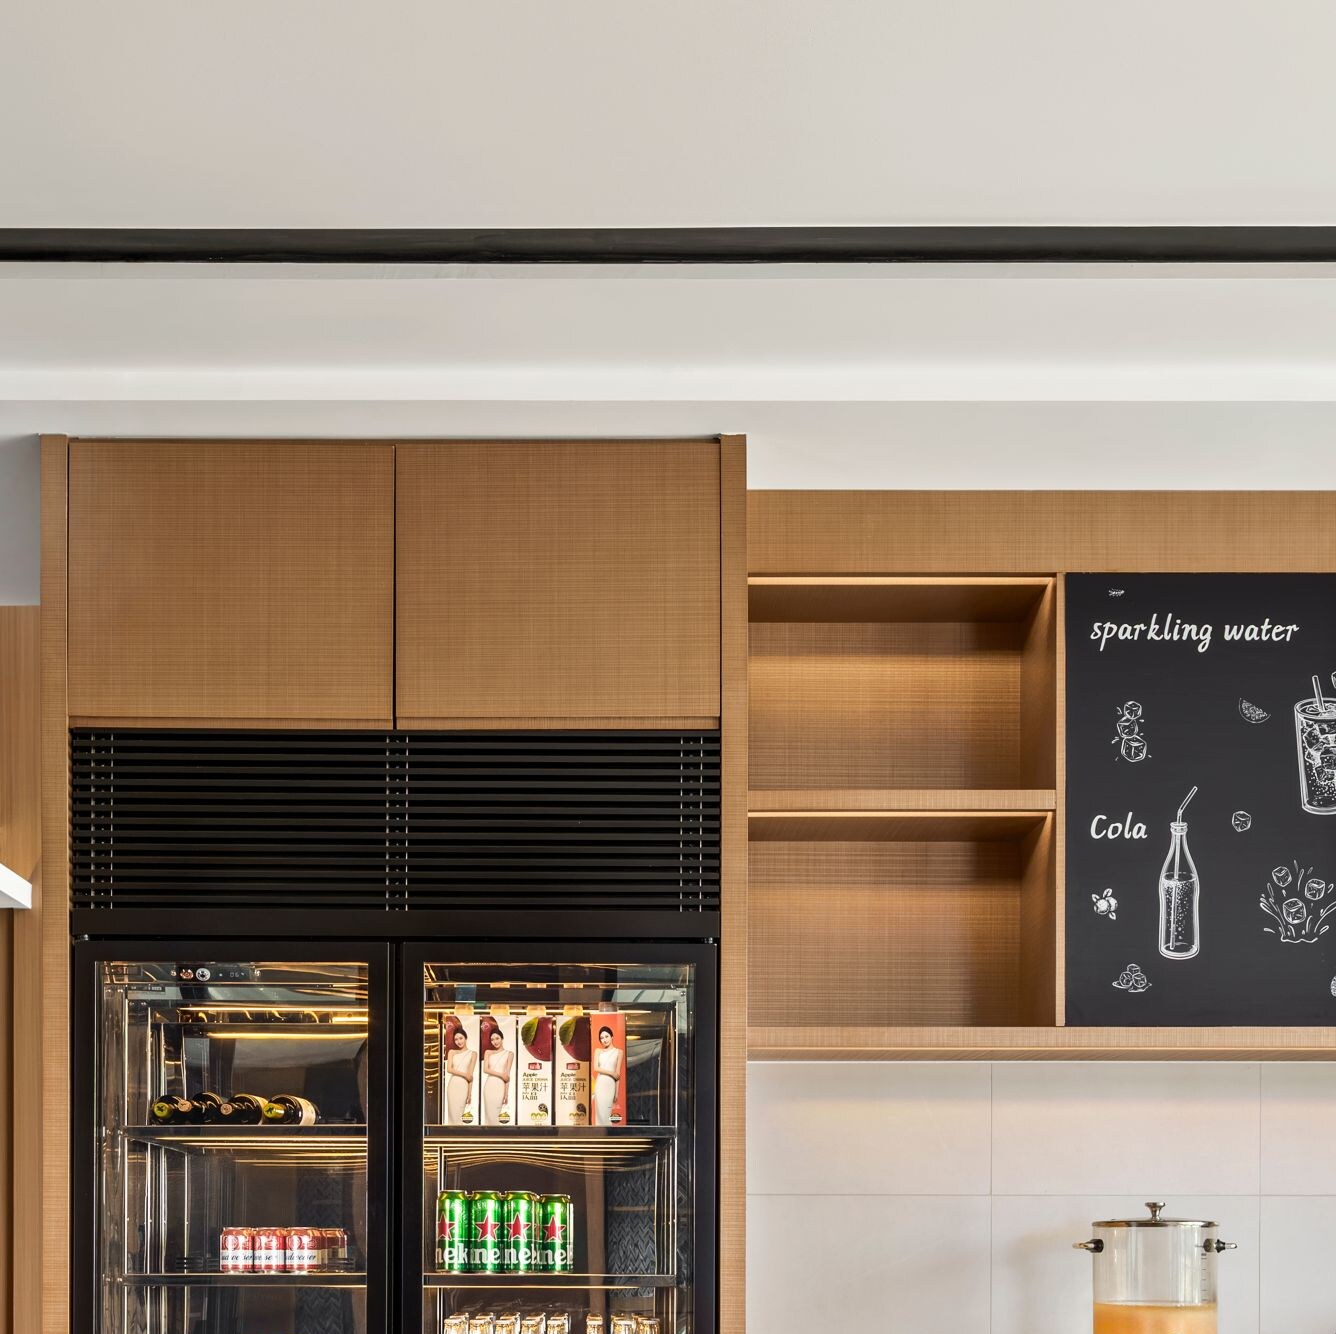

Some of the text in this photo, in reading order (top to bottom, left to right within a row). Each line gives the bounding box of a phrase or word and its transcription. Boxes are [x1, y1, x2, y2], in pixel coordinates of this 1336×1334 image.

[1090, 613, 1300, 652] sparkling water
[1090, 811, 1148, 840] Cola
[522, 1082, 548, 1092] 苹果汁
[560, 1082, 586, 1092] 苹果汁
